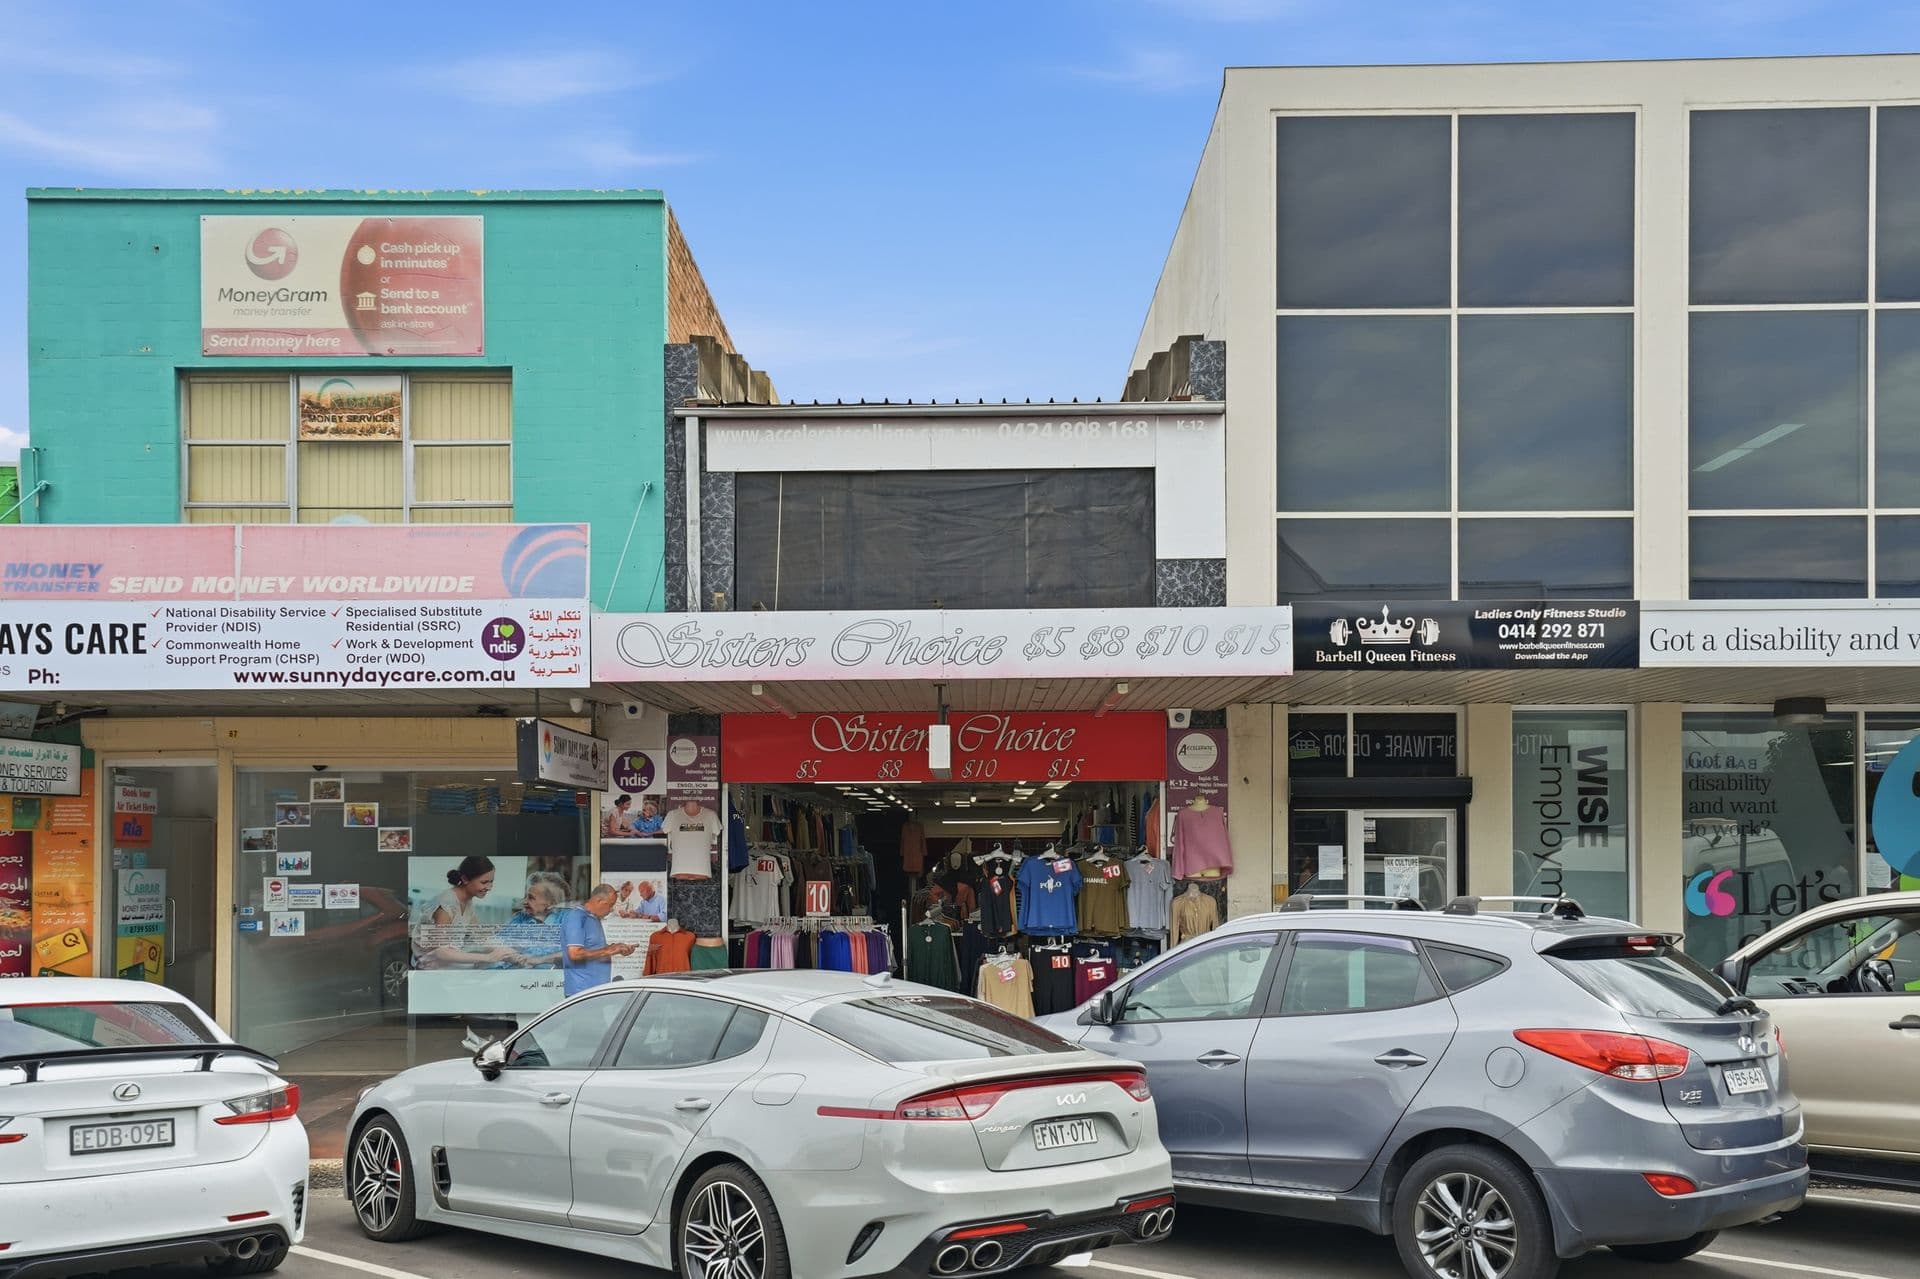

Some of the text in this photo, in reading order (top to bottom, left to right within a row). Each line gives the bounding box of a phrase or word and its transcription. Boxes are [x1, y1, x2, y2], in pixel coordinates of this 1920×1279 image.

[381, 242, 460, 255] Cash pick up
[381, 257, 394, 268] in
[218, 288, 327, 305] MoneyGram
[381, 289, 413, 298] Send
[416, 289, 429, 298] to
[233, 306, 312, 317] money transfer
[382, 303, 413, 313] bank
[209, 335, 340, 348] Send money here
[998, 422, 1053, 439] 0424
[1060, 421, 1100, 439] 808
[1108, 421, 1148, 439] 168
[1177, 420, 1204, 431] K-12
[4, 563, 103, 578] MONEY
[3, 581, 100, 592] TRANSFER
[107, 576, 475, 593] SEND MONEY WORLDWIDE
[166, 606, 326, 620] National Disability Service
[346, 606, 482, 618] Specialised Substitute
[1474, 607, 1627, 621] Ladies Only Fitness Studio
[166, 622, 261, 633] Provider (NDIS)
[346, 621, 461, 633] Residential (SSRC)
[1498, 623, 1605, 638] 0414 292 871
[64, 623, 147, 655] CARE
[166, 640, 300, 650] Commonwealth Home
[346, 638, 474, 651] Work & Development
[616, 618, 1290, 669] Sisters Choice $5 $8 $10 $15
[1650, 628, 1695, 651] Got
[1702, 633, 1718, 651] a
[1726, 626, 1842, 657] disability
[1850, 626, 1900, 651] and
[489, 641, 518, 654] ndis
[166, 654, 320, 665] Support Program (CHSP)
[346, 653, 425, 665] Order (WDO)
[1315, 649, 1457, 664] Barbell Queen Fitness
[1515, 652, 1589, 661] Download the App
[28, 668, 60, 684] Ph:
[233, 667, 516, 687] www.sunnydaycare.com.au
[811, 714, 1076, 752] Sister Choice
[1689, 751, 1721, 769] Got
[1726, 755, 1738, 769] a
[24, 765, 67, 779] SERVICES
[797, 758, 1085, 779] $5 $8 $10 $15
[2, 779, 52, 792] & TOURISM
[620, 773, 649, 787] ndis
[1169, 779, 1189, 787] K-12
[1689, 773, 1771, 795] disability
[1577, 746, 1609, 848] WISE
[1689, 796, 1777, 814] and want
[1690, 819, 1770, 837] to work?
